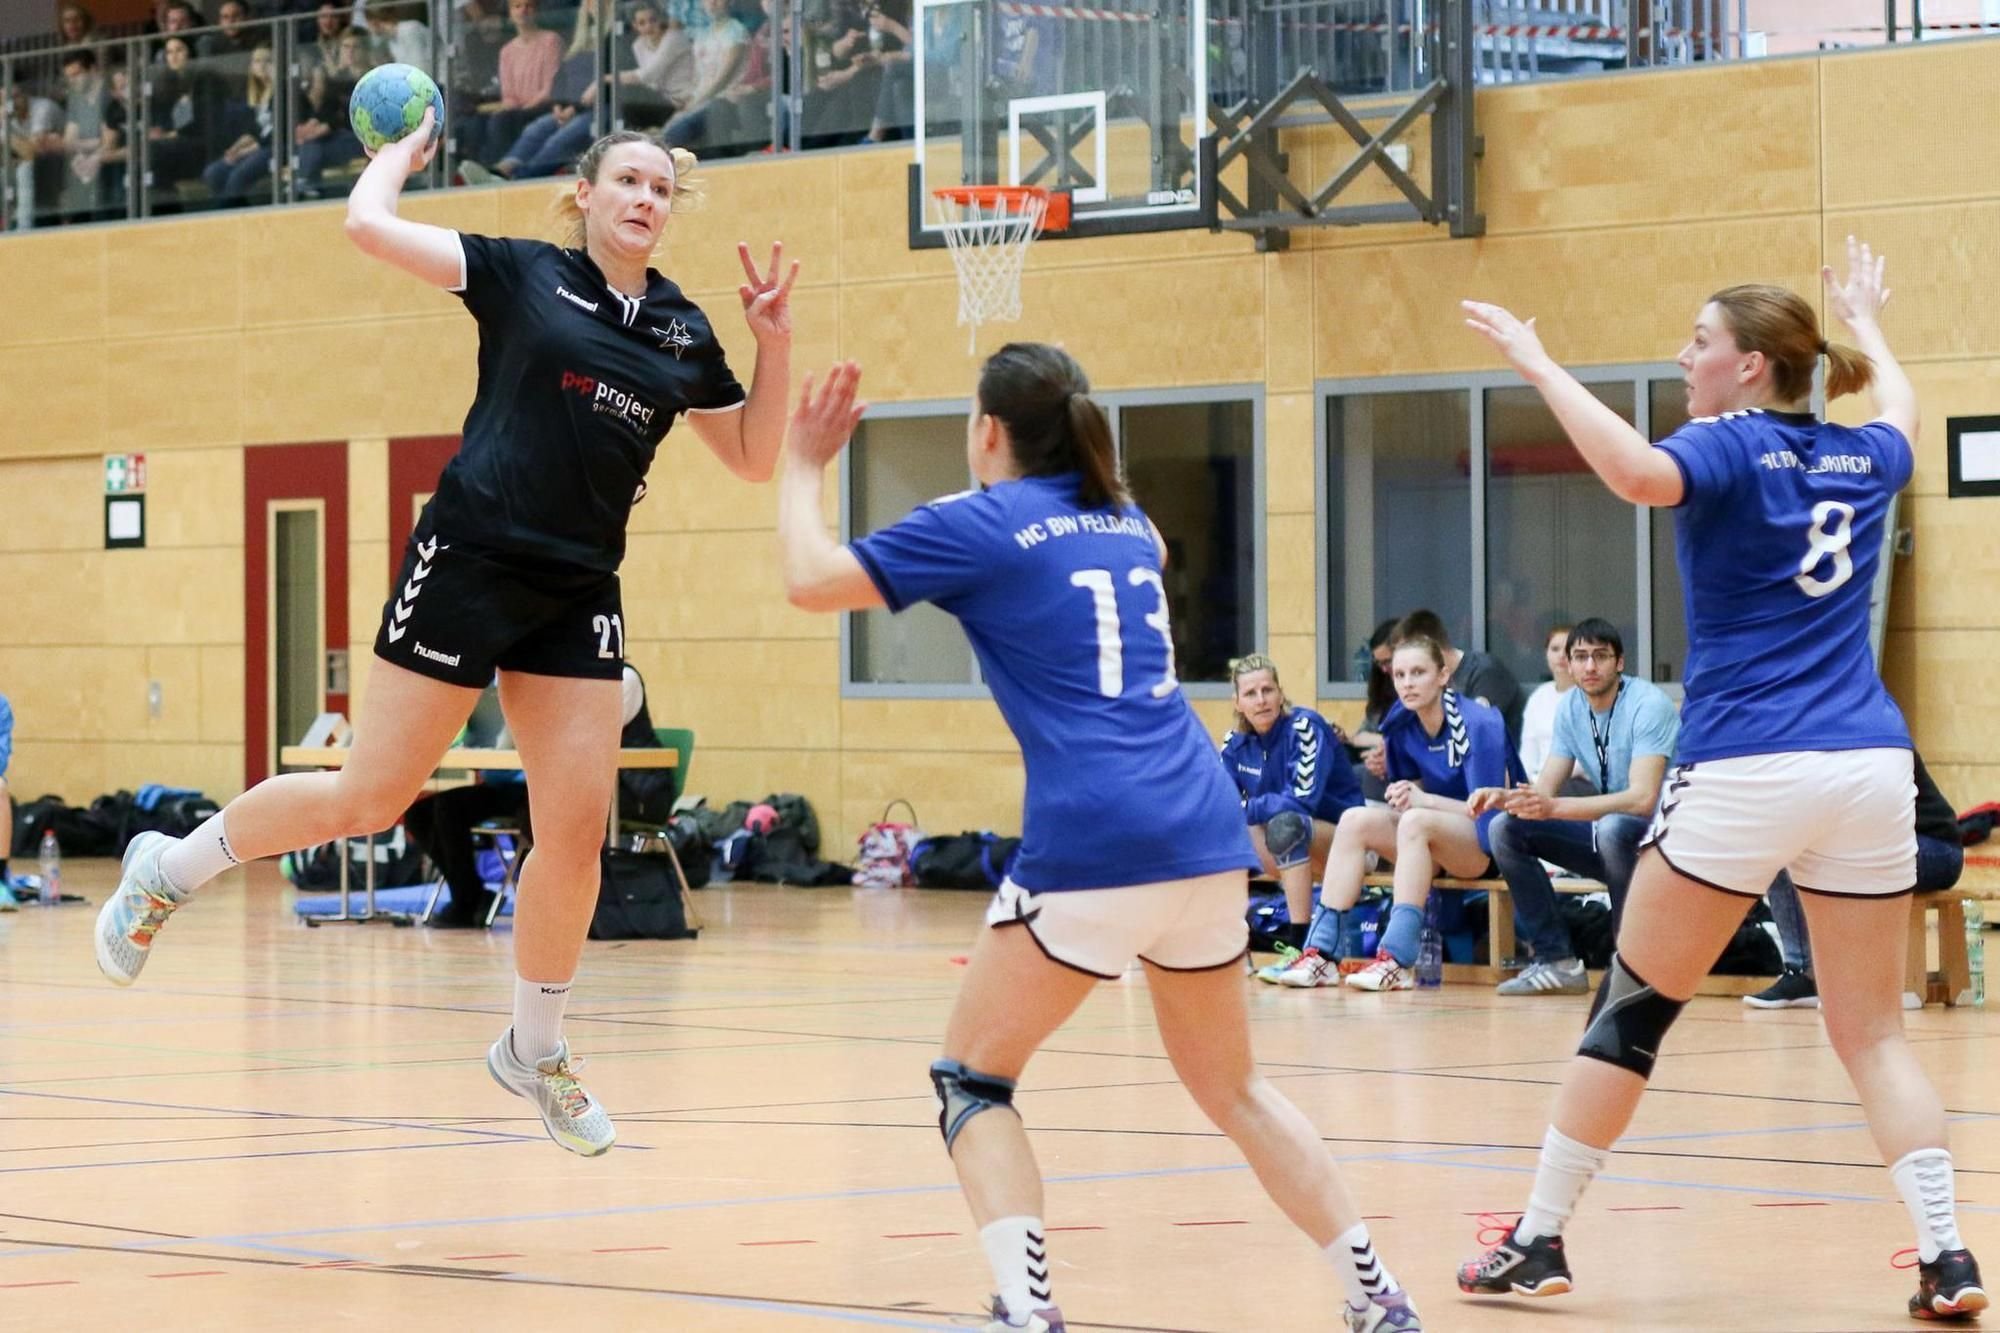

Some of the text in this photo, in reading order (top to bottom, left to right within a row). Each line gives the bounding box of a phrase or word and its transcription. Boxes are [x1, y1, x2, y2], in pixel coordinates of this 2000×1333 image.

[556, 286, 599, 312] hummel
[1014, 523, 1048, 549] HC
[1045, 516, 1079, 537] BW
[1794, 500, 1855, 598] 8
[592, 614, 623, 659] 21
[1070, 566, 1180, 699] 13
[413, 640, 461, 667] hummel
